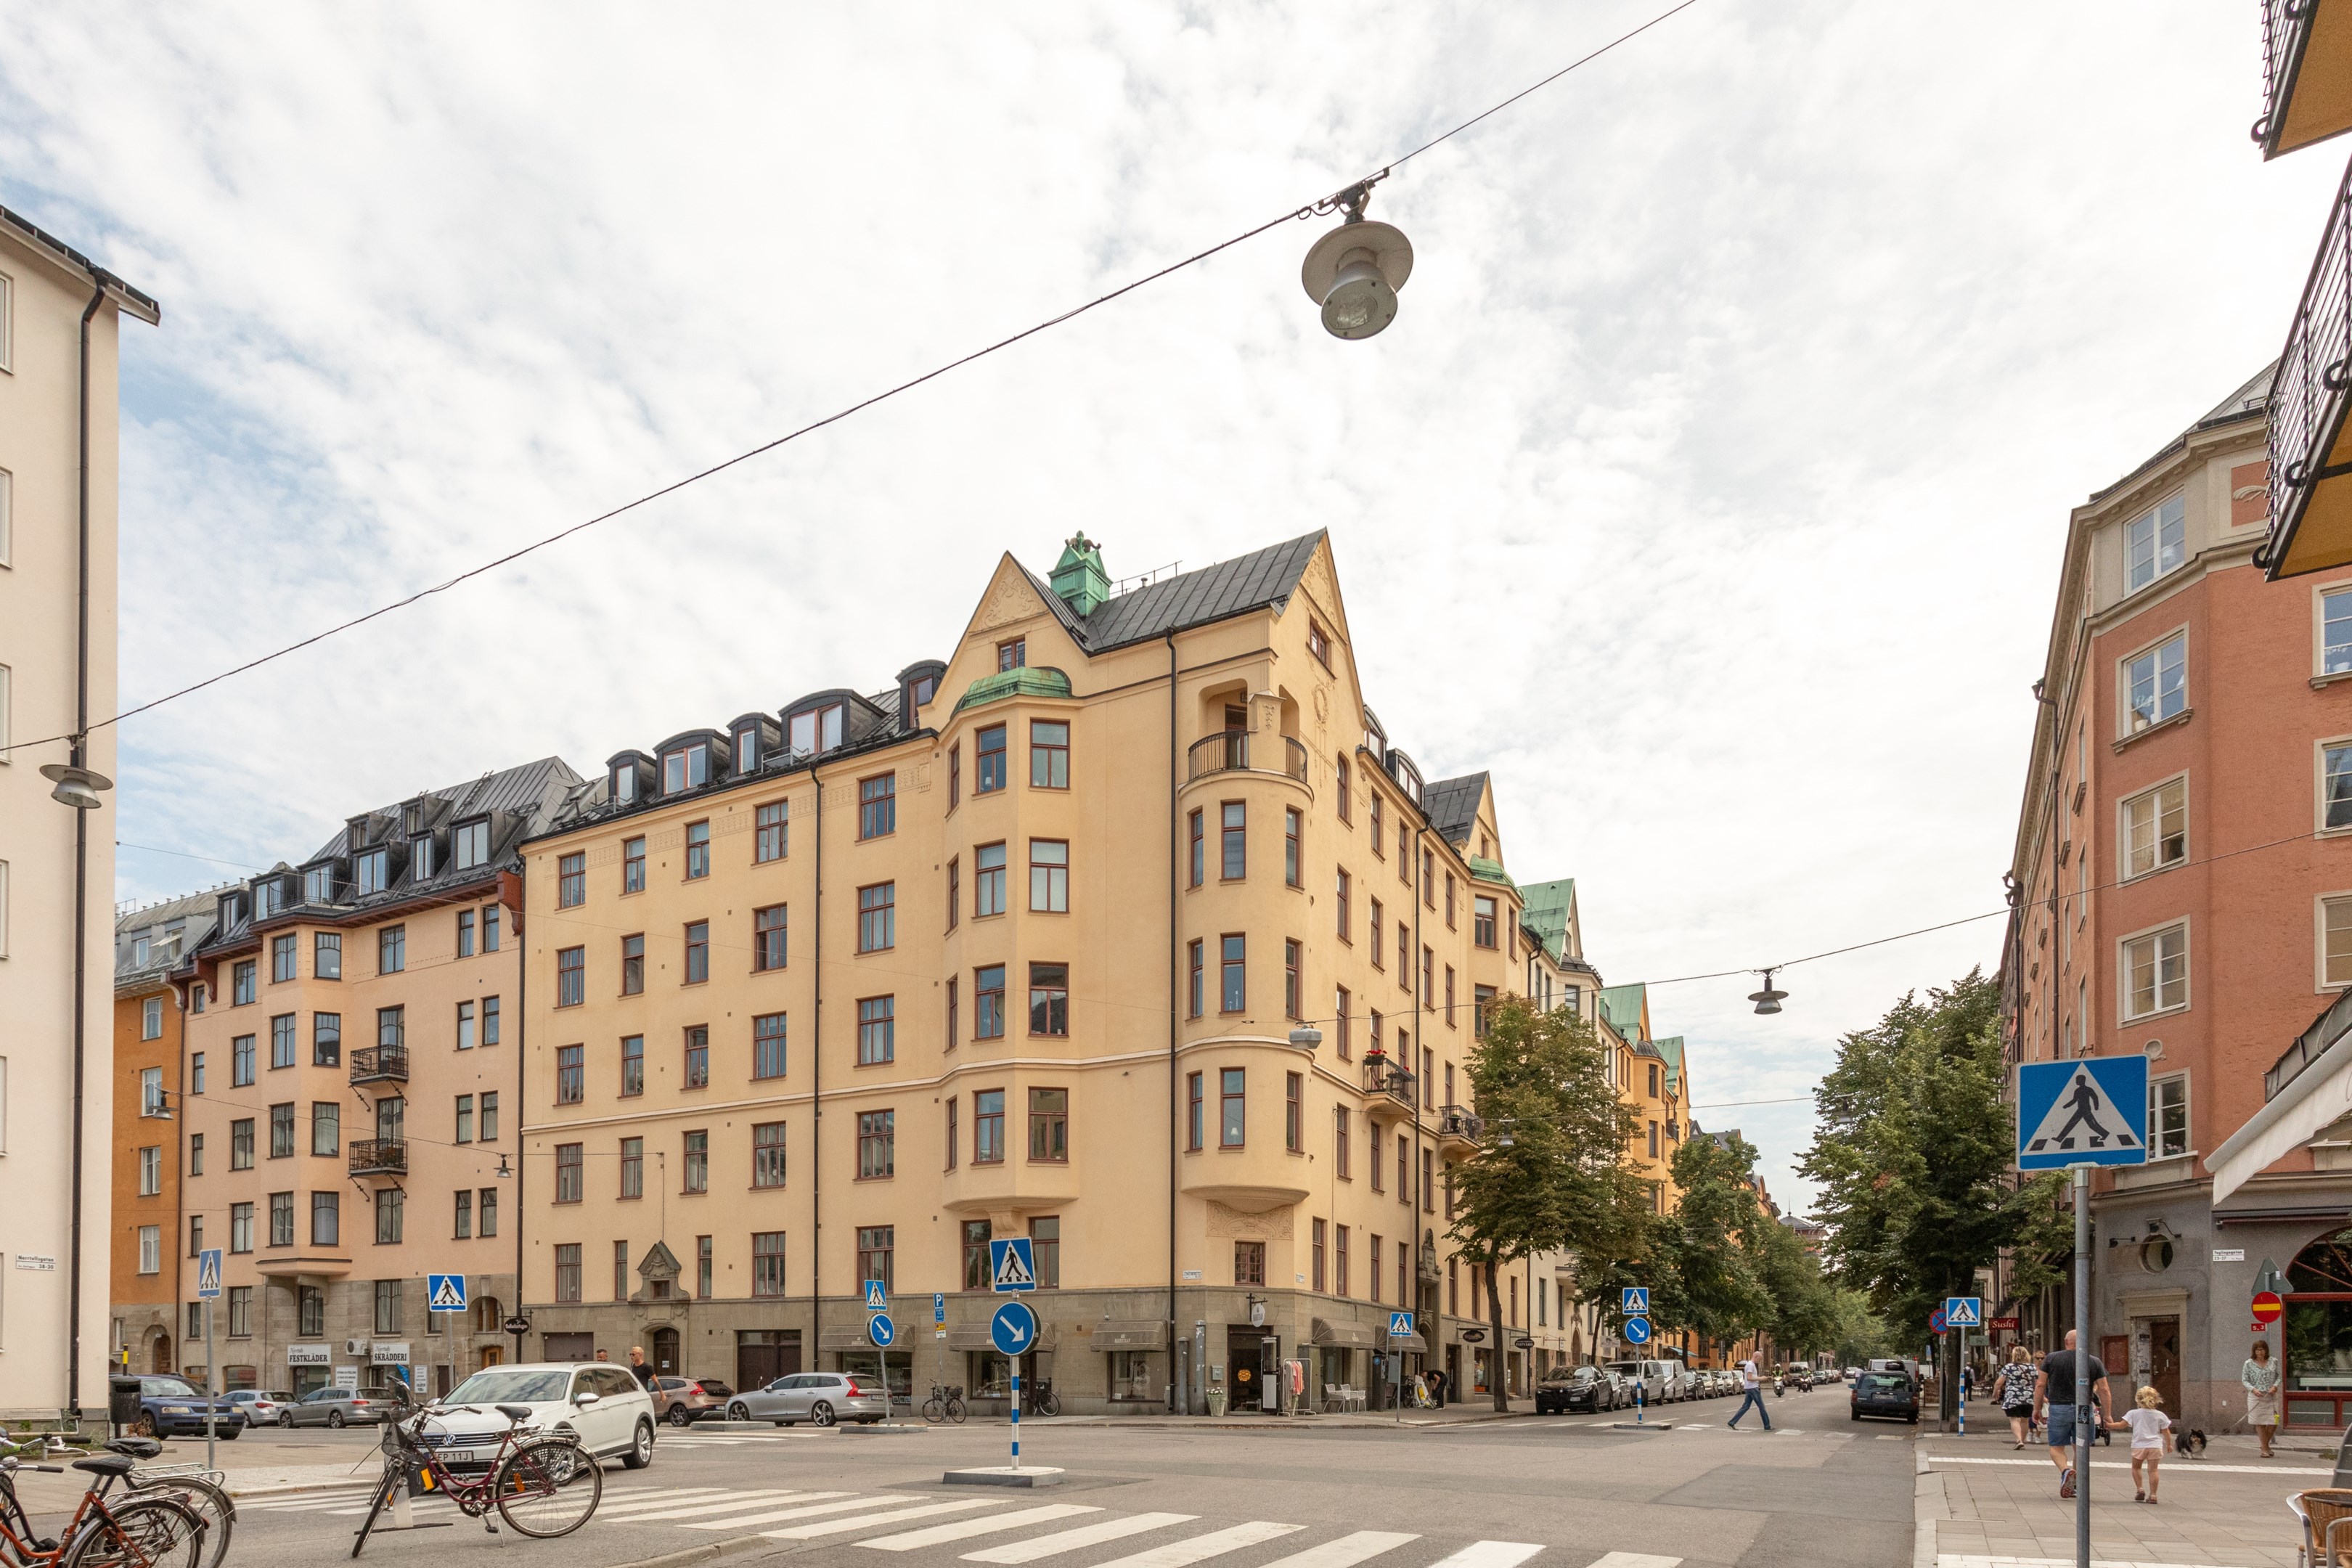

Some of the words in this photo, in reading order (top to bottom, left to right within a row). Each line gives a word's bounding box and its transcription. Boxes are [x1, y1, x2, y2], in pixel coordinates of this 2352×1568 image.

[936, 1294, 942, 1306] P
[1992, 1319, 2015, 1328] Sushi
[289, 1353, 328, 1363] FESTKLÄDER
[375, 1352, 407, 1361] SKRÄDDERI
